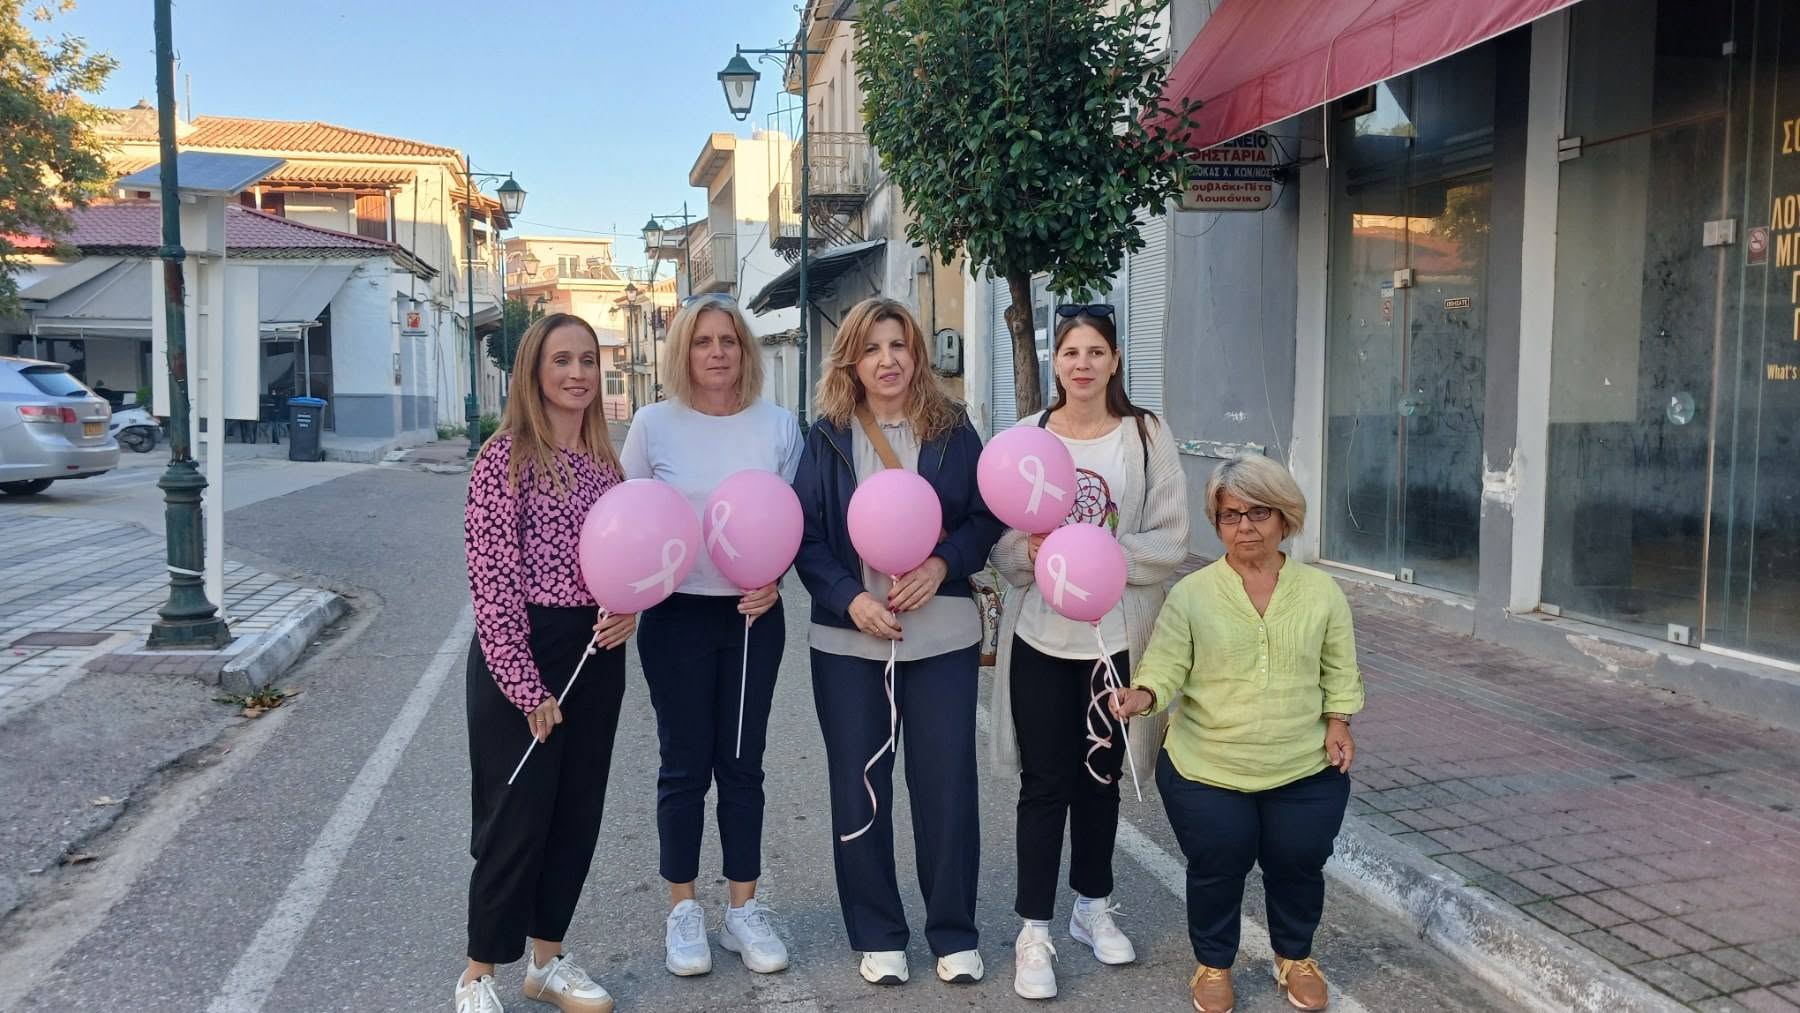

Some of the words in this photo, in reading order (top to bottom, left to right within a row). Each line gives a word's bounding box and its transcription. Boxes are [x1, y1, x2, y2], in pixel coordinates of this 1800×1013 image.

[1190, 182, 1272, 192] ουβλάκι-Πίτα
[1195, 193, 1261, 202] Λουκάνικο
[1767, 363, 1798, 380] What's
